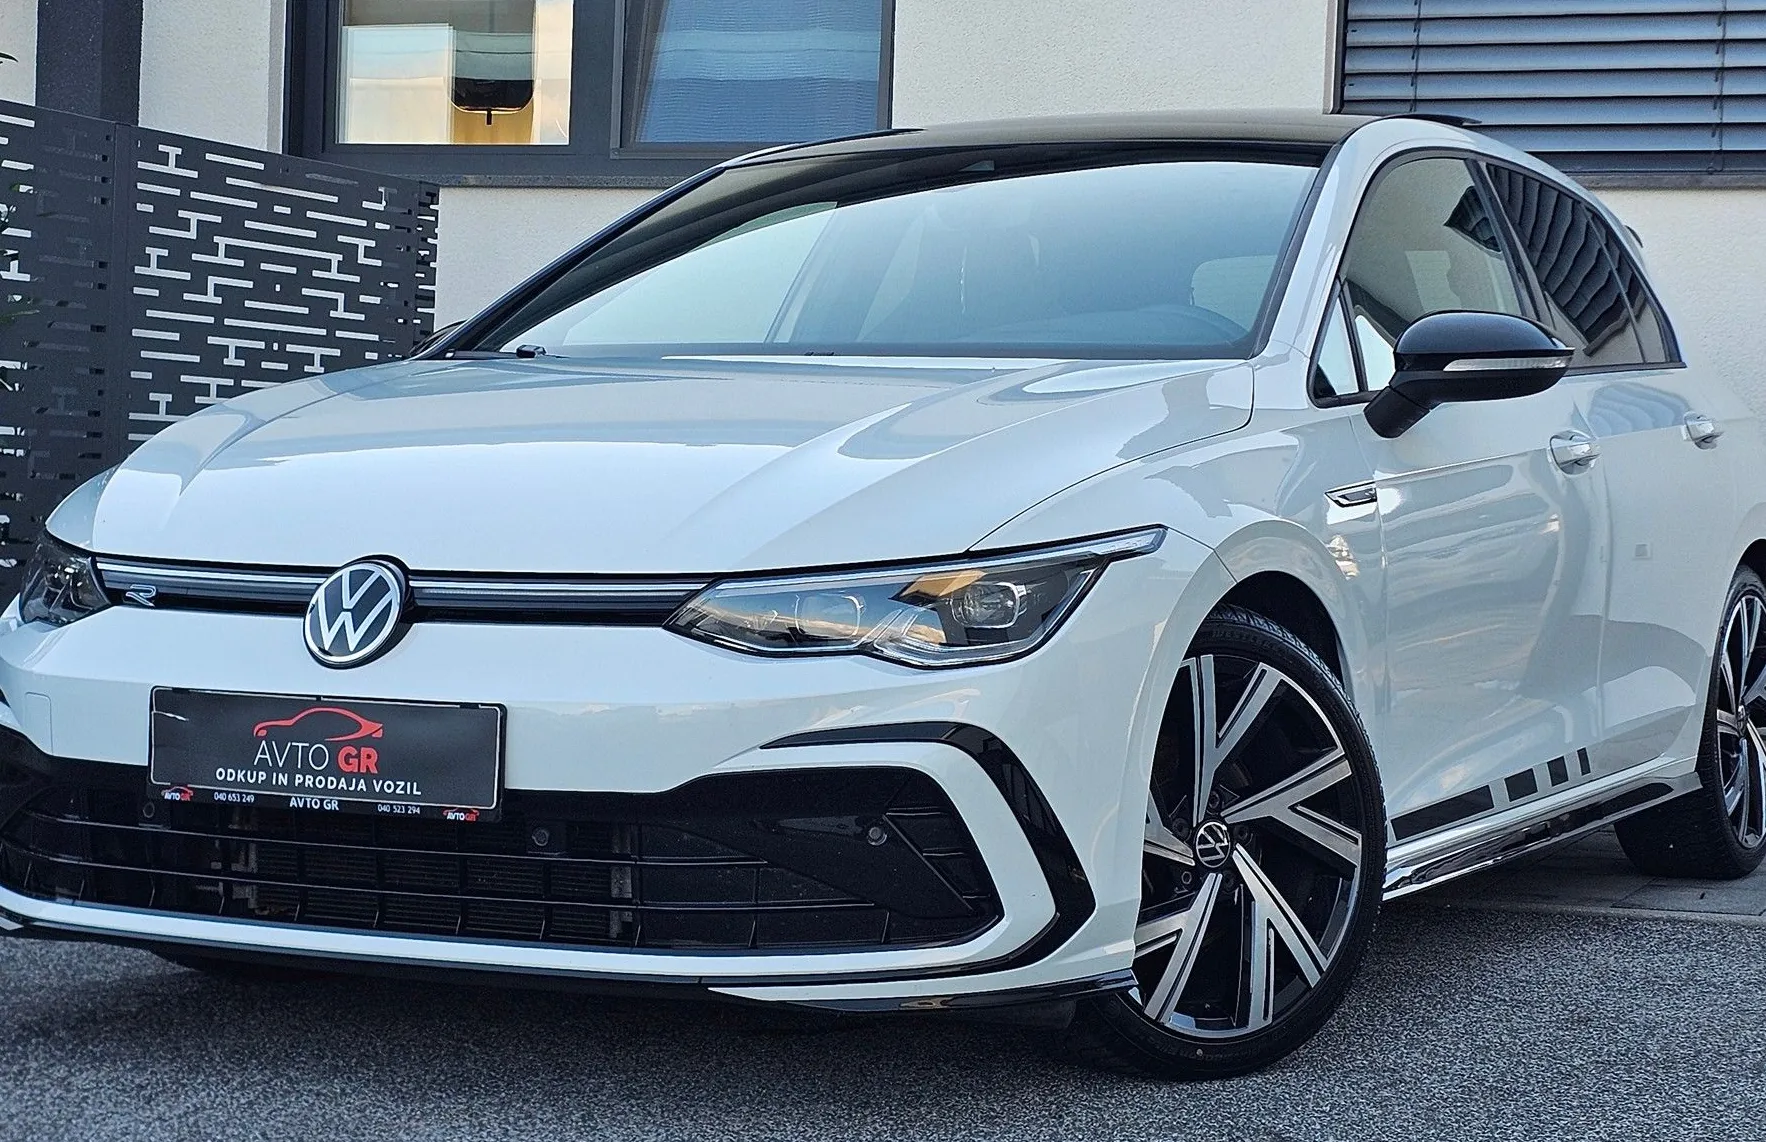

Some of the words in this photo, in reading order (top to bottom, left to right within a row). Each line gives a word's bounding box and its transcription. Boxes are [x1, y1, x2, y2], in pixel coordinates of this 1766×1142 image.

[253, 740, 329, 771] AVTO
[337, 746, 379, 774] GR
[215, 768, 267, 785] ODKUP
[272, 773, 288, 786] IN
[294, 774, 367, 792] PRODAJA
[373, 780, 422, 796] VOZIL
[213, 791, 227, 802] 040
[241, 793, 255, 803] 249
[289, 797, 320, 810] AVTO
[323, 799, 340, 811] GR
[377, 803, 391, 813] 040
[392, 805, 405, 814] 523
[407, 805, 421, 814] 294
